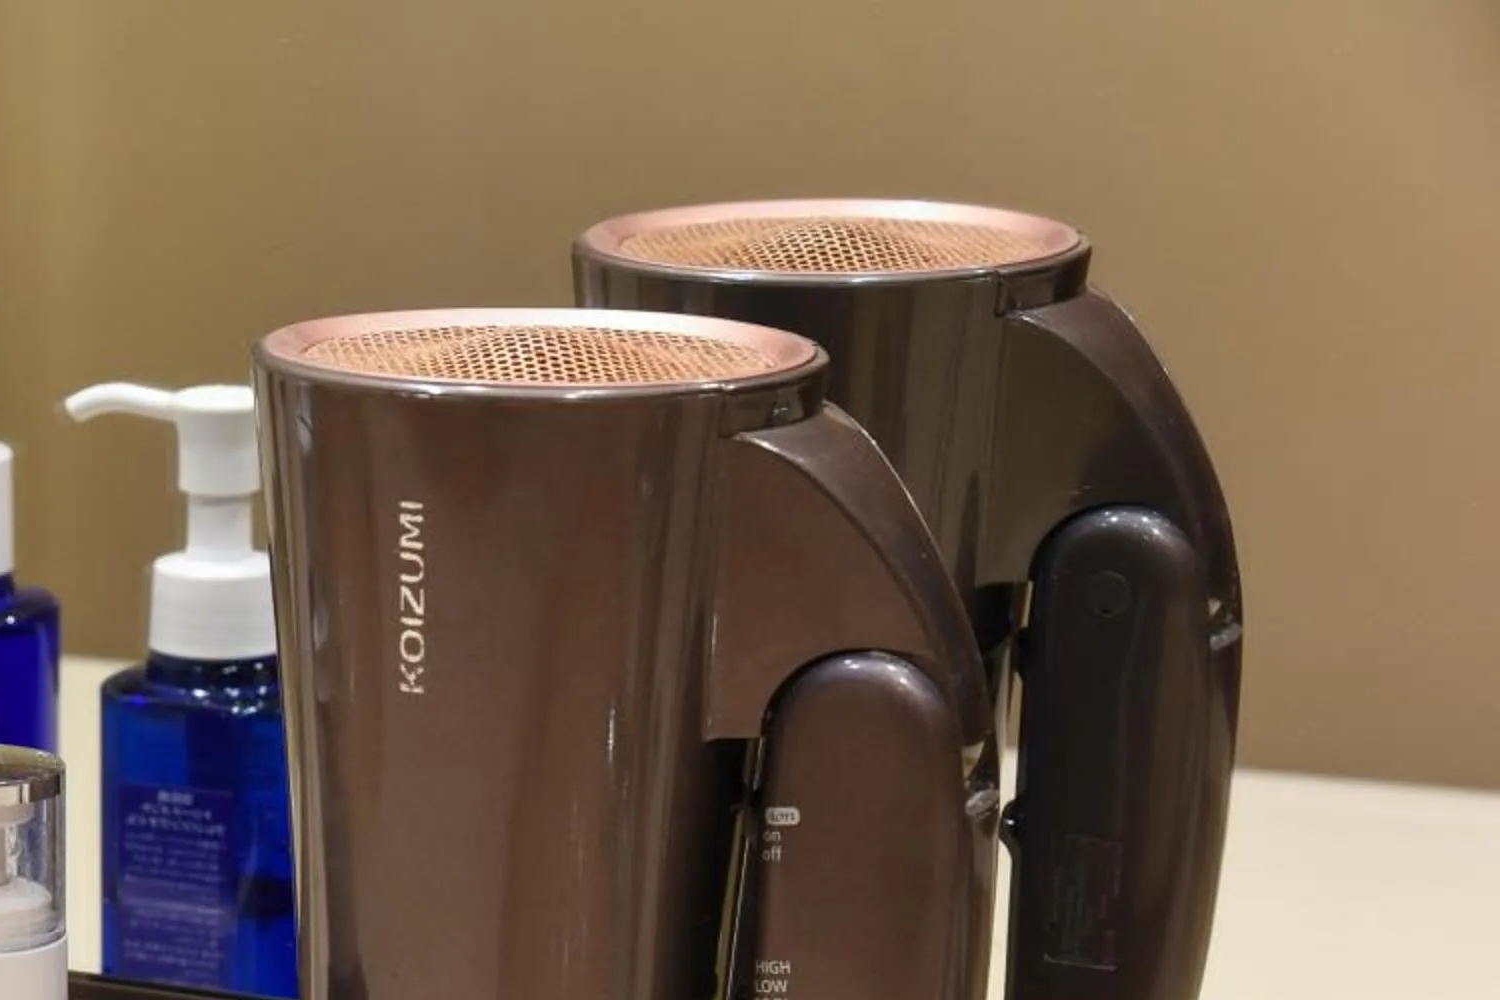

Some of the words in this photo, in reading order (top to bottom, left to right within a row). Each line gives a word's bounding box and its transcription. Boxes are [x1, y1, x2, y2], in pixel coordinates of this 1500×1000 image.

[399, 501, 425, 694] KOIZUMI
[761, 845, 781, 863] off
[755, 960, 791, 975] HIGH
[754, 979, 788, 994] LOW
